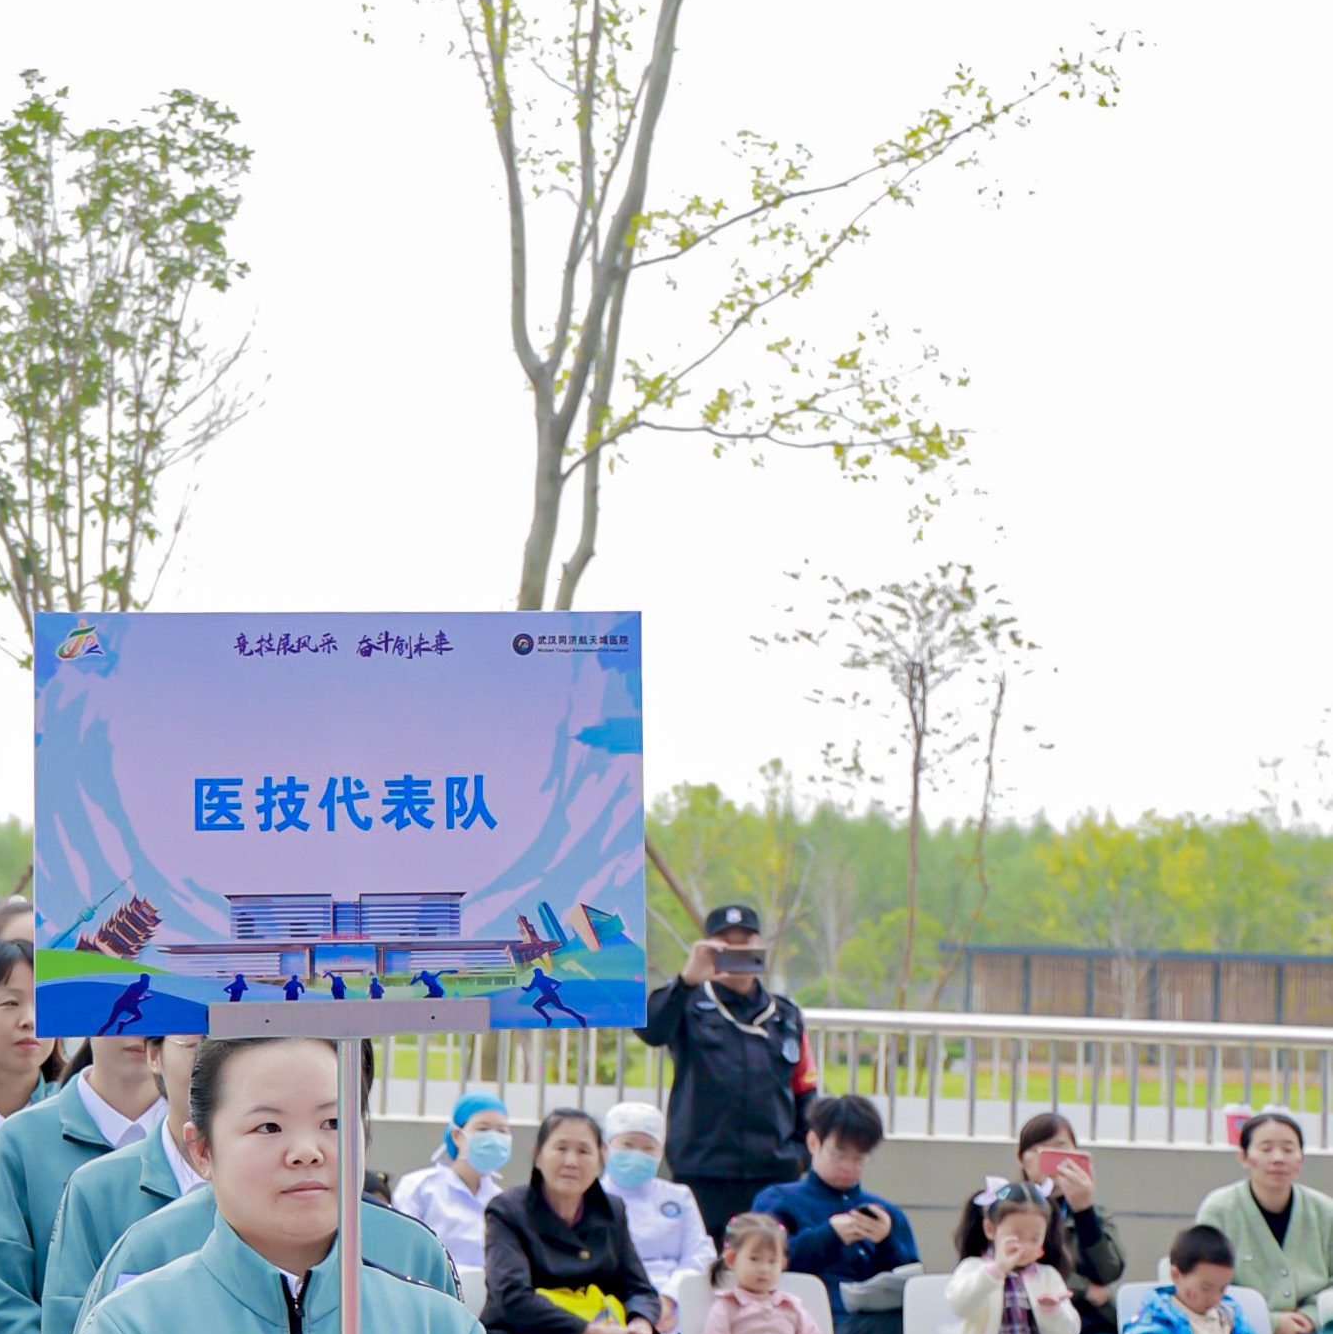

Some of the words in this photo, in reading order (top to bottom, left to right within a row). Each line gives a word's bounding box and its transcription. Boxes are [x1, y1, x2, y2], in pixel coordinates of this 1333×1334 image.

[233, 632, 339, 657] 竞技展风采
[356, 630, 455, 659] 奋斗创未来
[537, 635, 629, 645] 武汉同济航天城医院
[194, 774, 498, 832] 医技代表队
